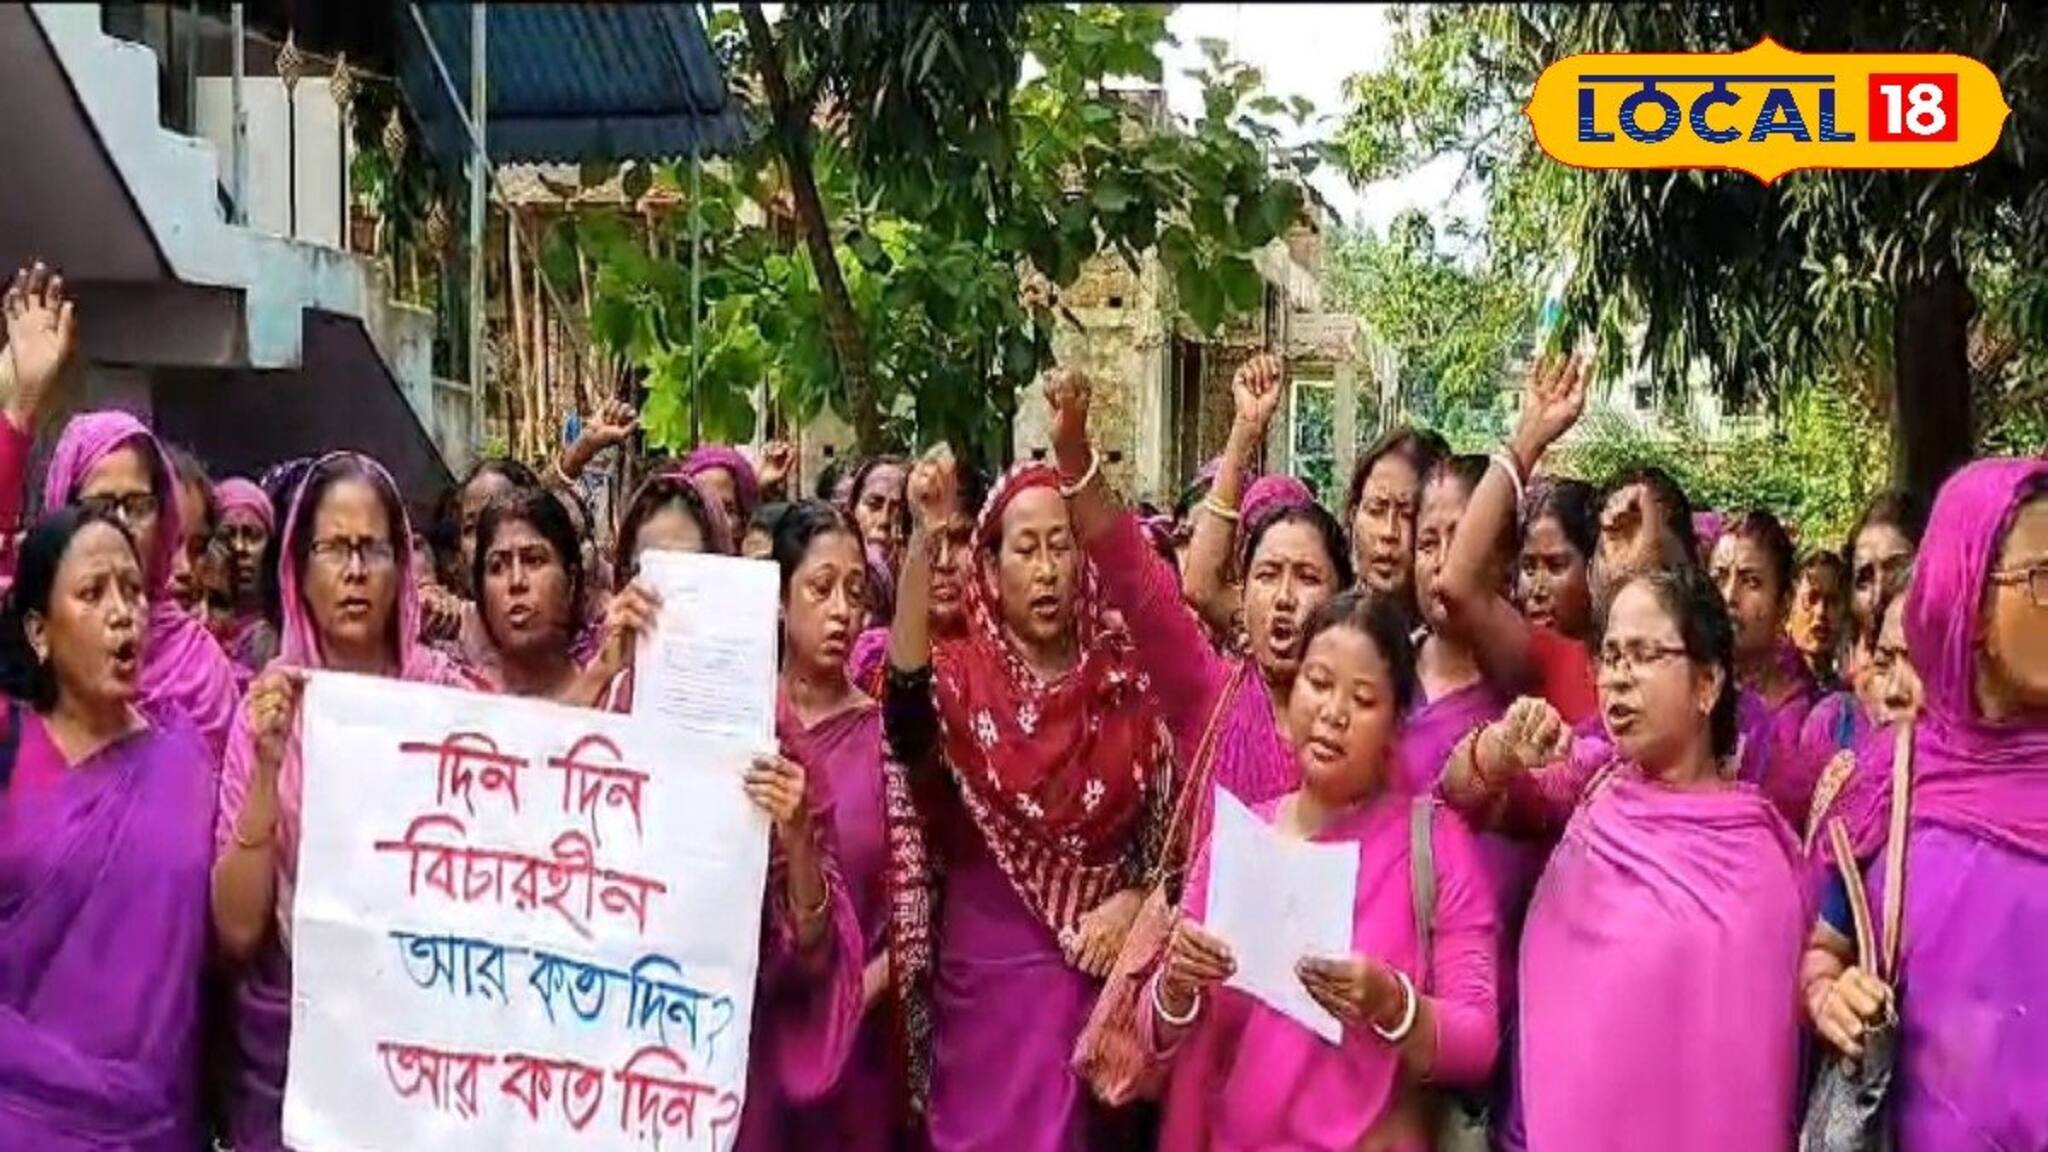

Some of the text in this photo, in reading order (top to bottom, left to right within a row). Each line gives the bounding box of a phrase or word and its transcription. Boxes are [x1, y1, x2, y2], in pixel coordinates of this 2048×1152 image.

[400, 732, 651, 849] দিন দিন
[374, 814, 667, 938] বিচারহীন
[389, 930, 735, 1068] আর কত দিন?
[378, 1042, 496, 1120] আর
[501, 1053, 604, 1131] কত
